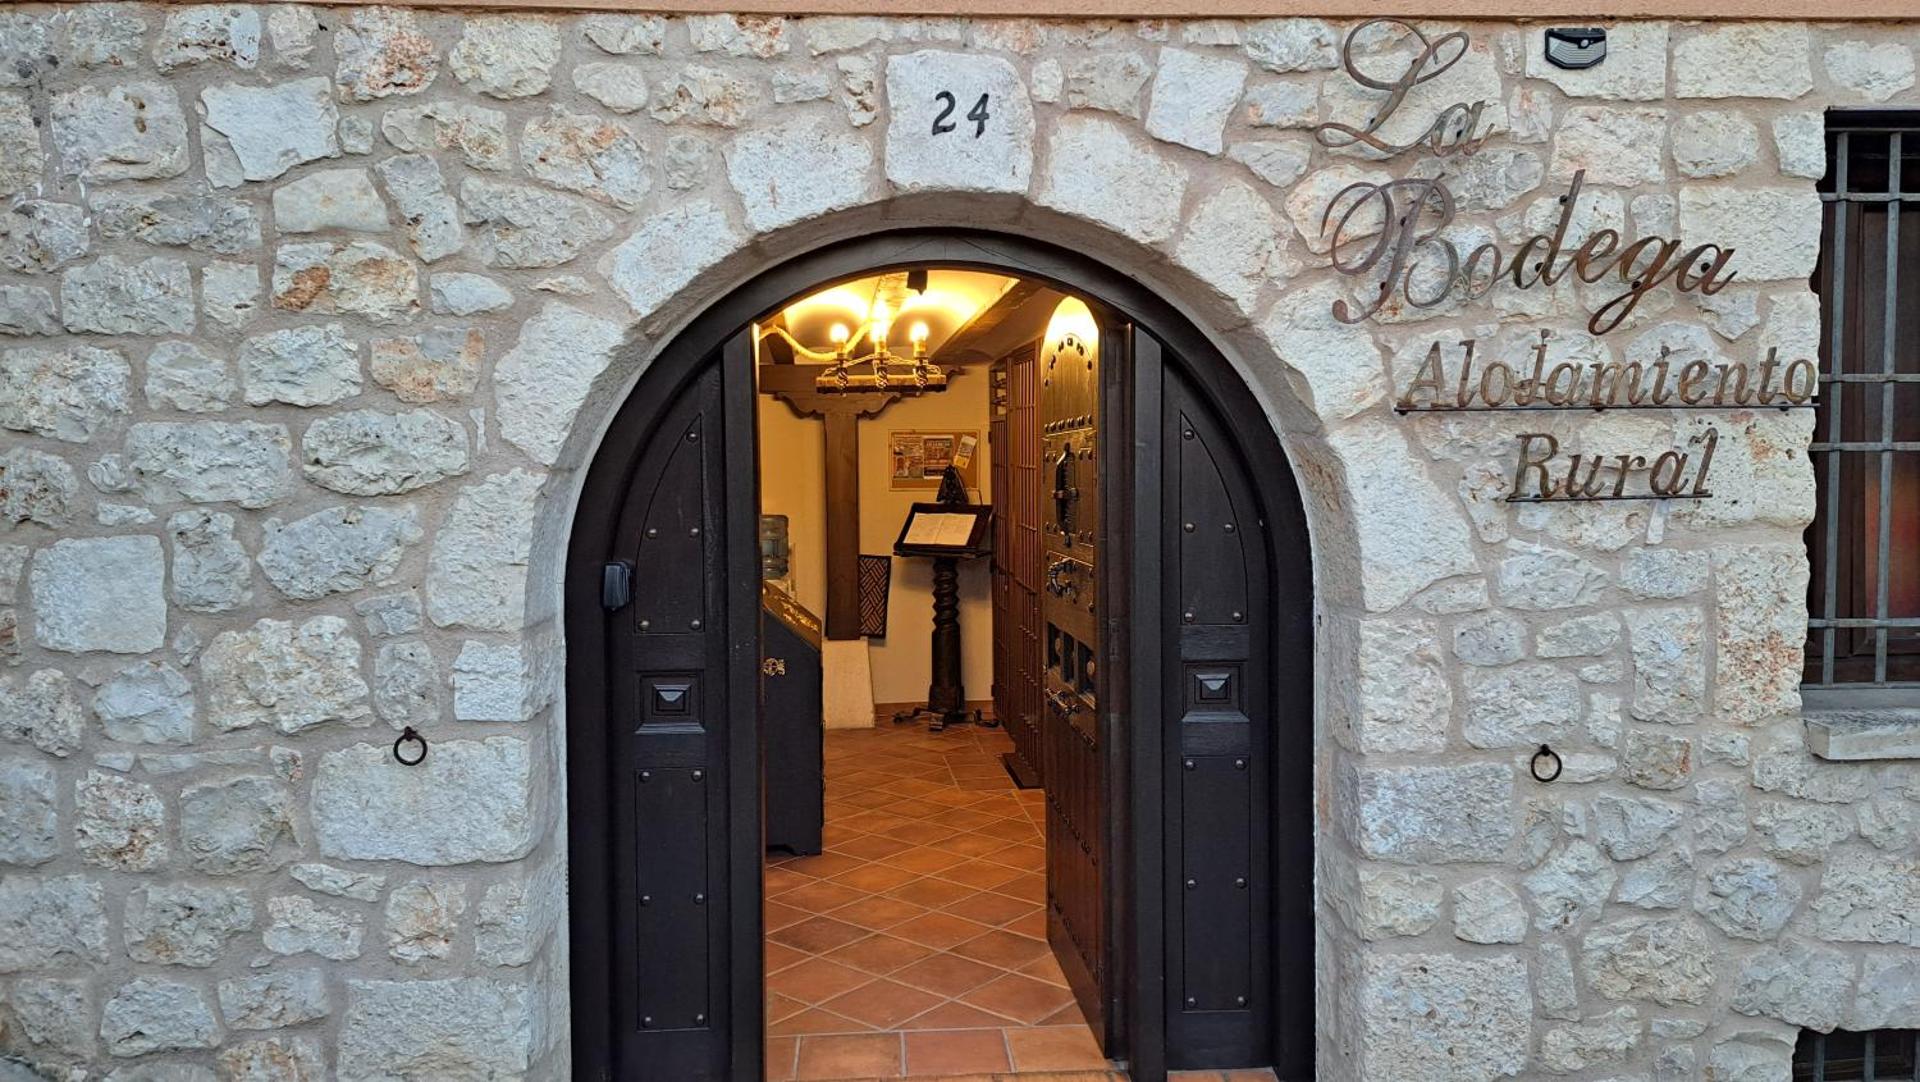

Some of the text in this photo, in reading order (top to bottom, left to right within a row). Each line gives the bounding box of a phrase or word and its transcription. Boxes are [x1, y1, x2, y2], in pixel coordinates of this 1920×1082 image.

[932, 91, 990, 138] 24
[1315, 18, 1496, 157] La
[1320, 170, 1738, 336] Bodega
[1397, 330, 1816, 407] Alojamiento
[1509, 427, 1719, 498] Rural
